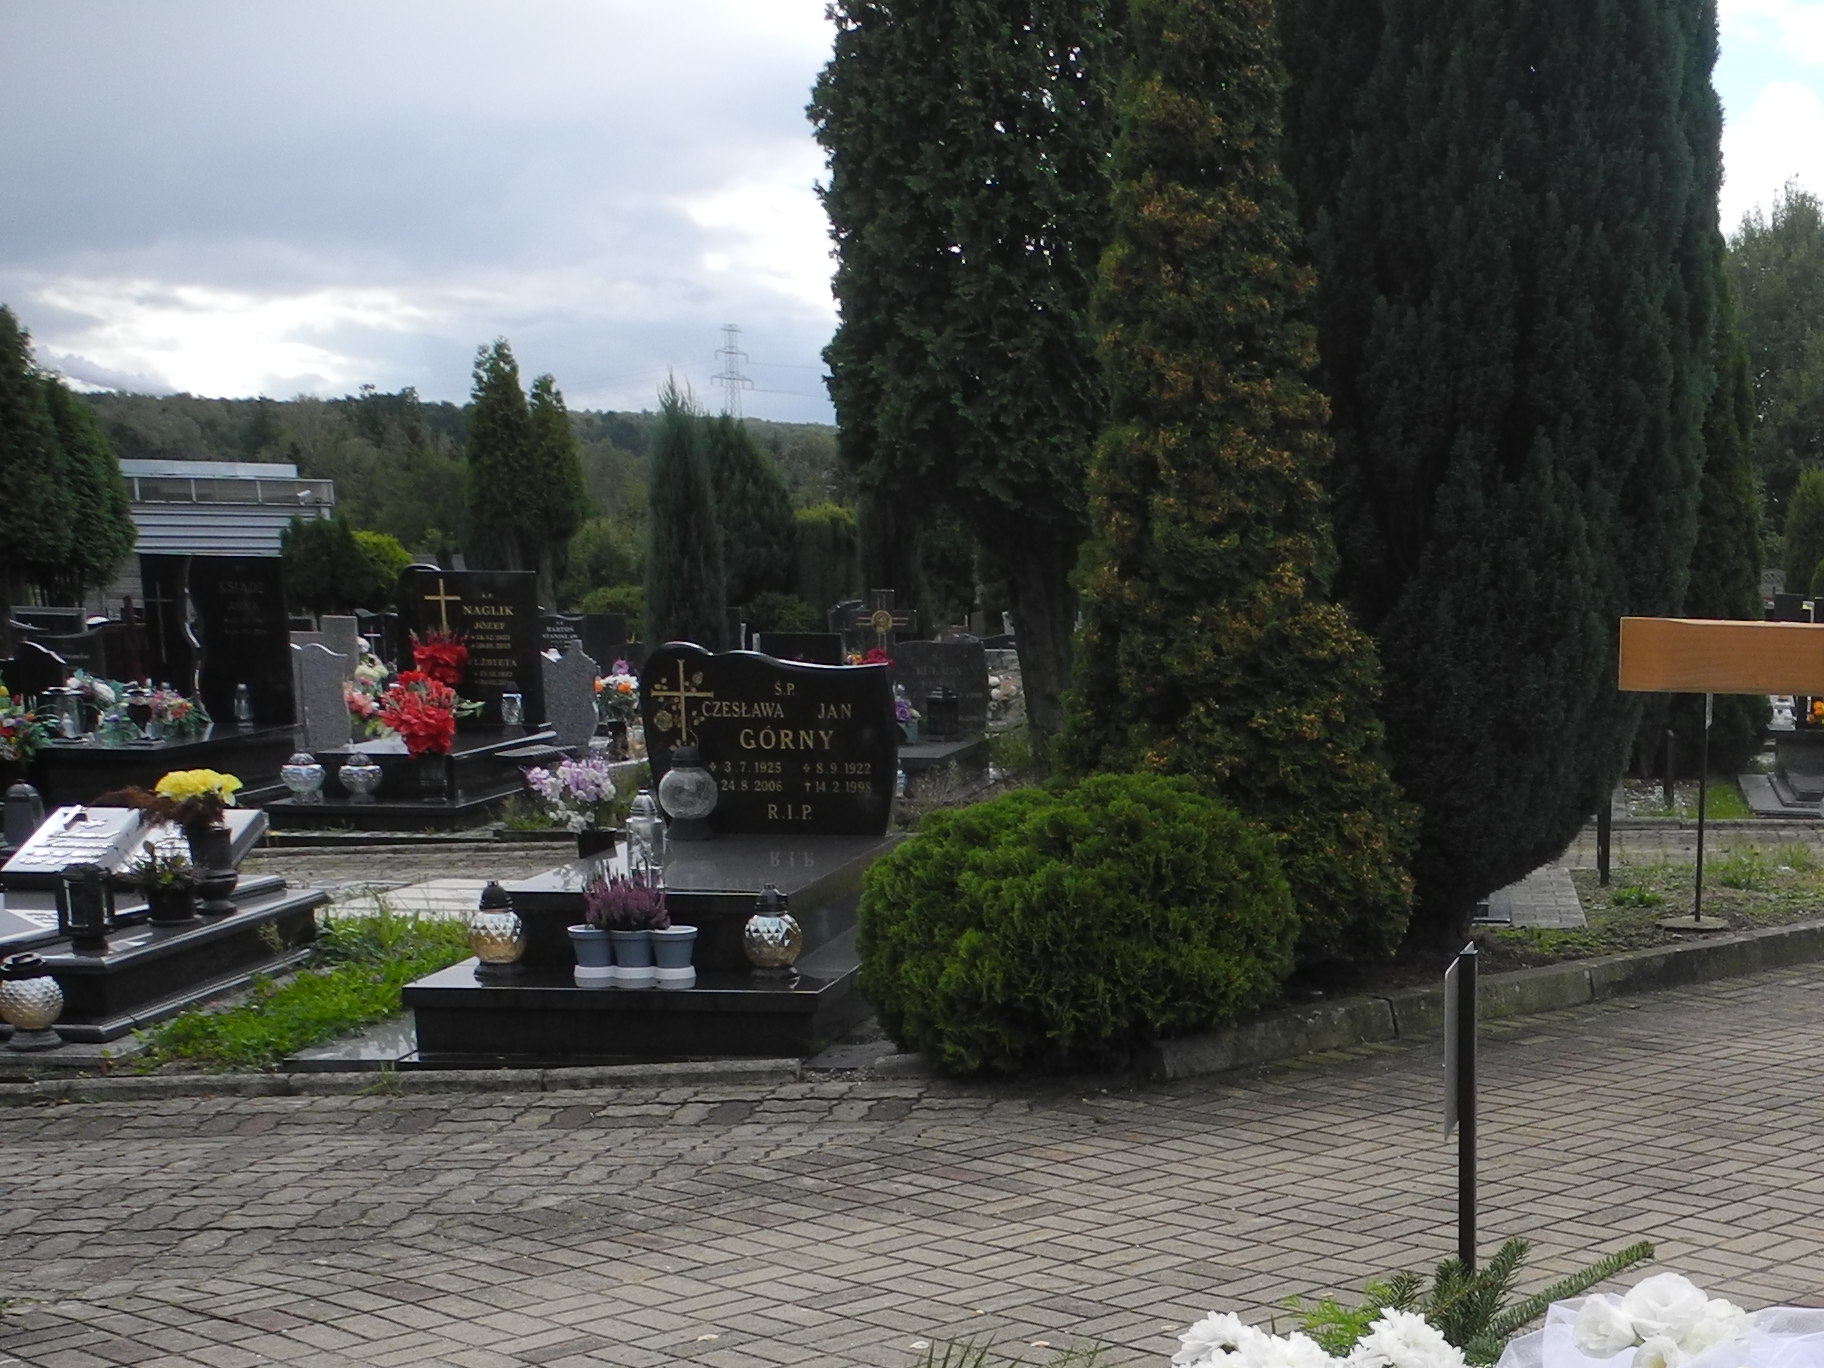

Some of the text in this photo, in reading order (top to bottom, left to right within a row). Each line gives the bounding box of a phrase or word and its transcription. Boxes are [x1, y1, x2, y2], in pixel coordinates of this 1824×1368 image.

[463, 605, 514, 616] NAGLIK
[473, 621, 506, 630] JÓZEF
[773, 680, 796, 696] Ś.P.
[701, 700, 852, 719] CZESŁAWA JAN
[740, 724, 834, 750] GÓRNY
[768, 804, 813, 820] R.I.P.
